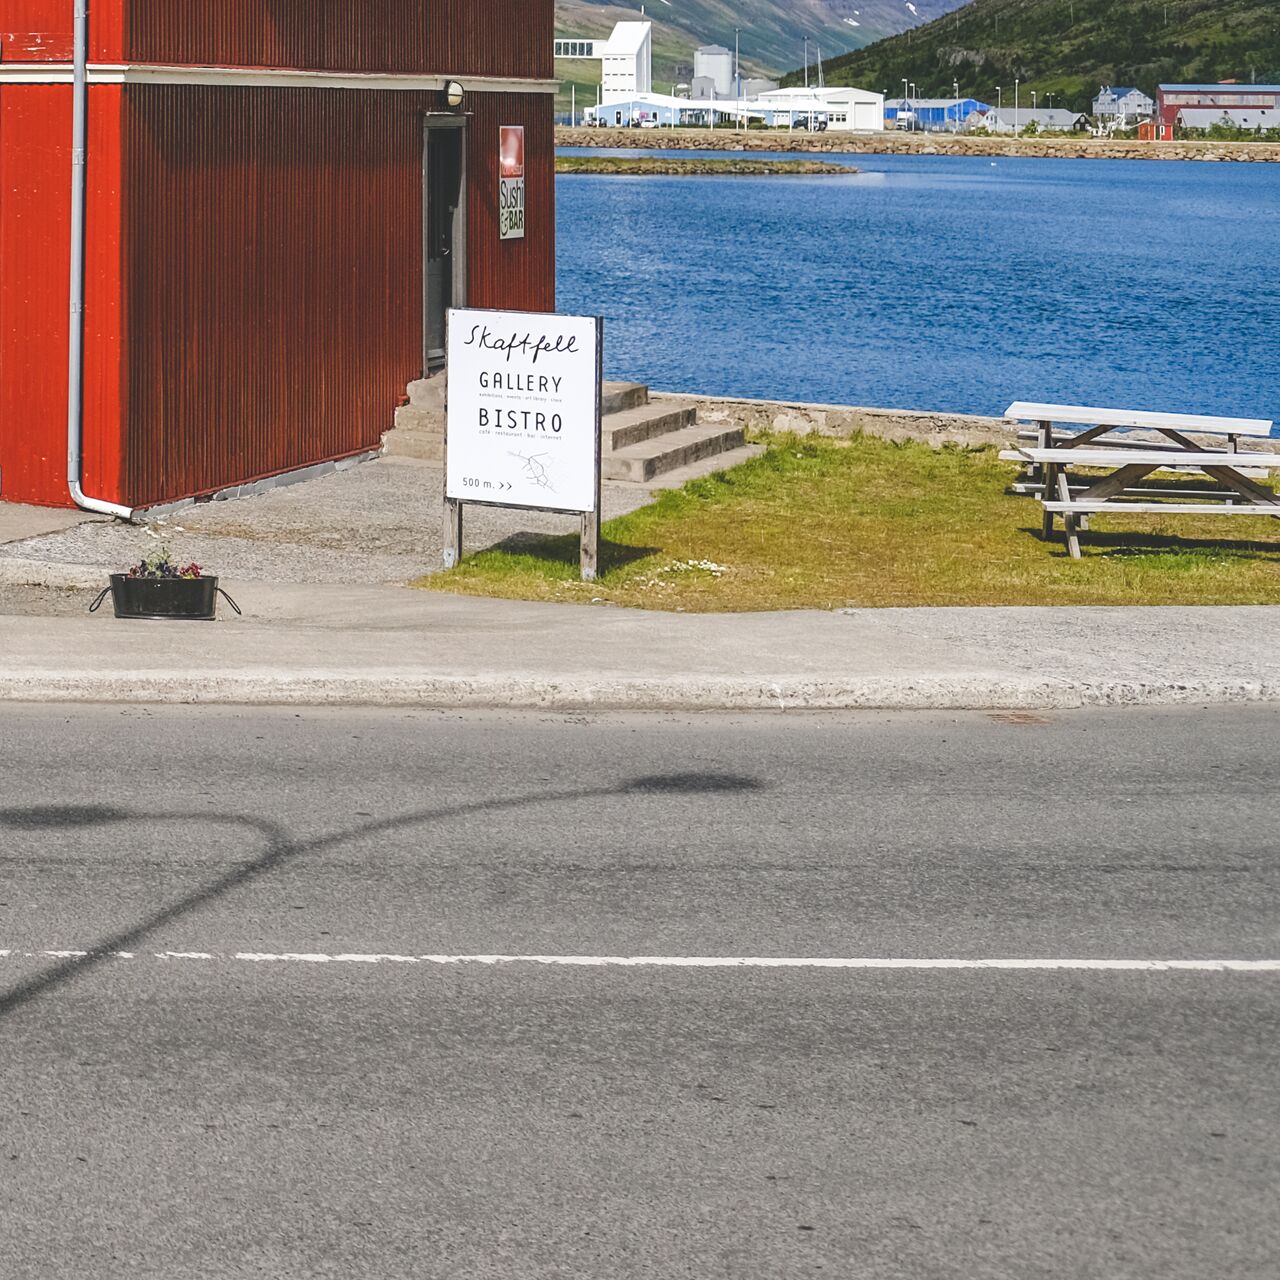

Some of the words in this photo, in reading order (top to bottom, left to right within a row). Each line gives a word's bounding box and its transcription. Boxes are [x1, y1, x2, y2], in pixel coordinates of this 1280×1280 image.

[500, 180, 524, 209] Sushi
[509, 209, 524, 231] BAR
[463, 325, 580, 364] Skaftfell
[479, 371, 562, 393] GALLERY
[479, 408, 563, 433] BISTRO
[462, 477, 480, 488] 500
